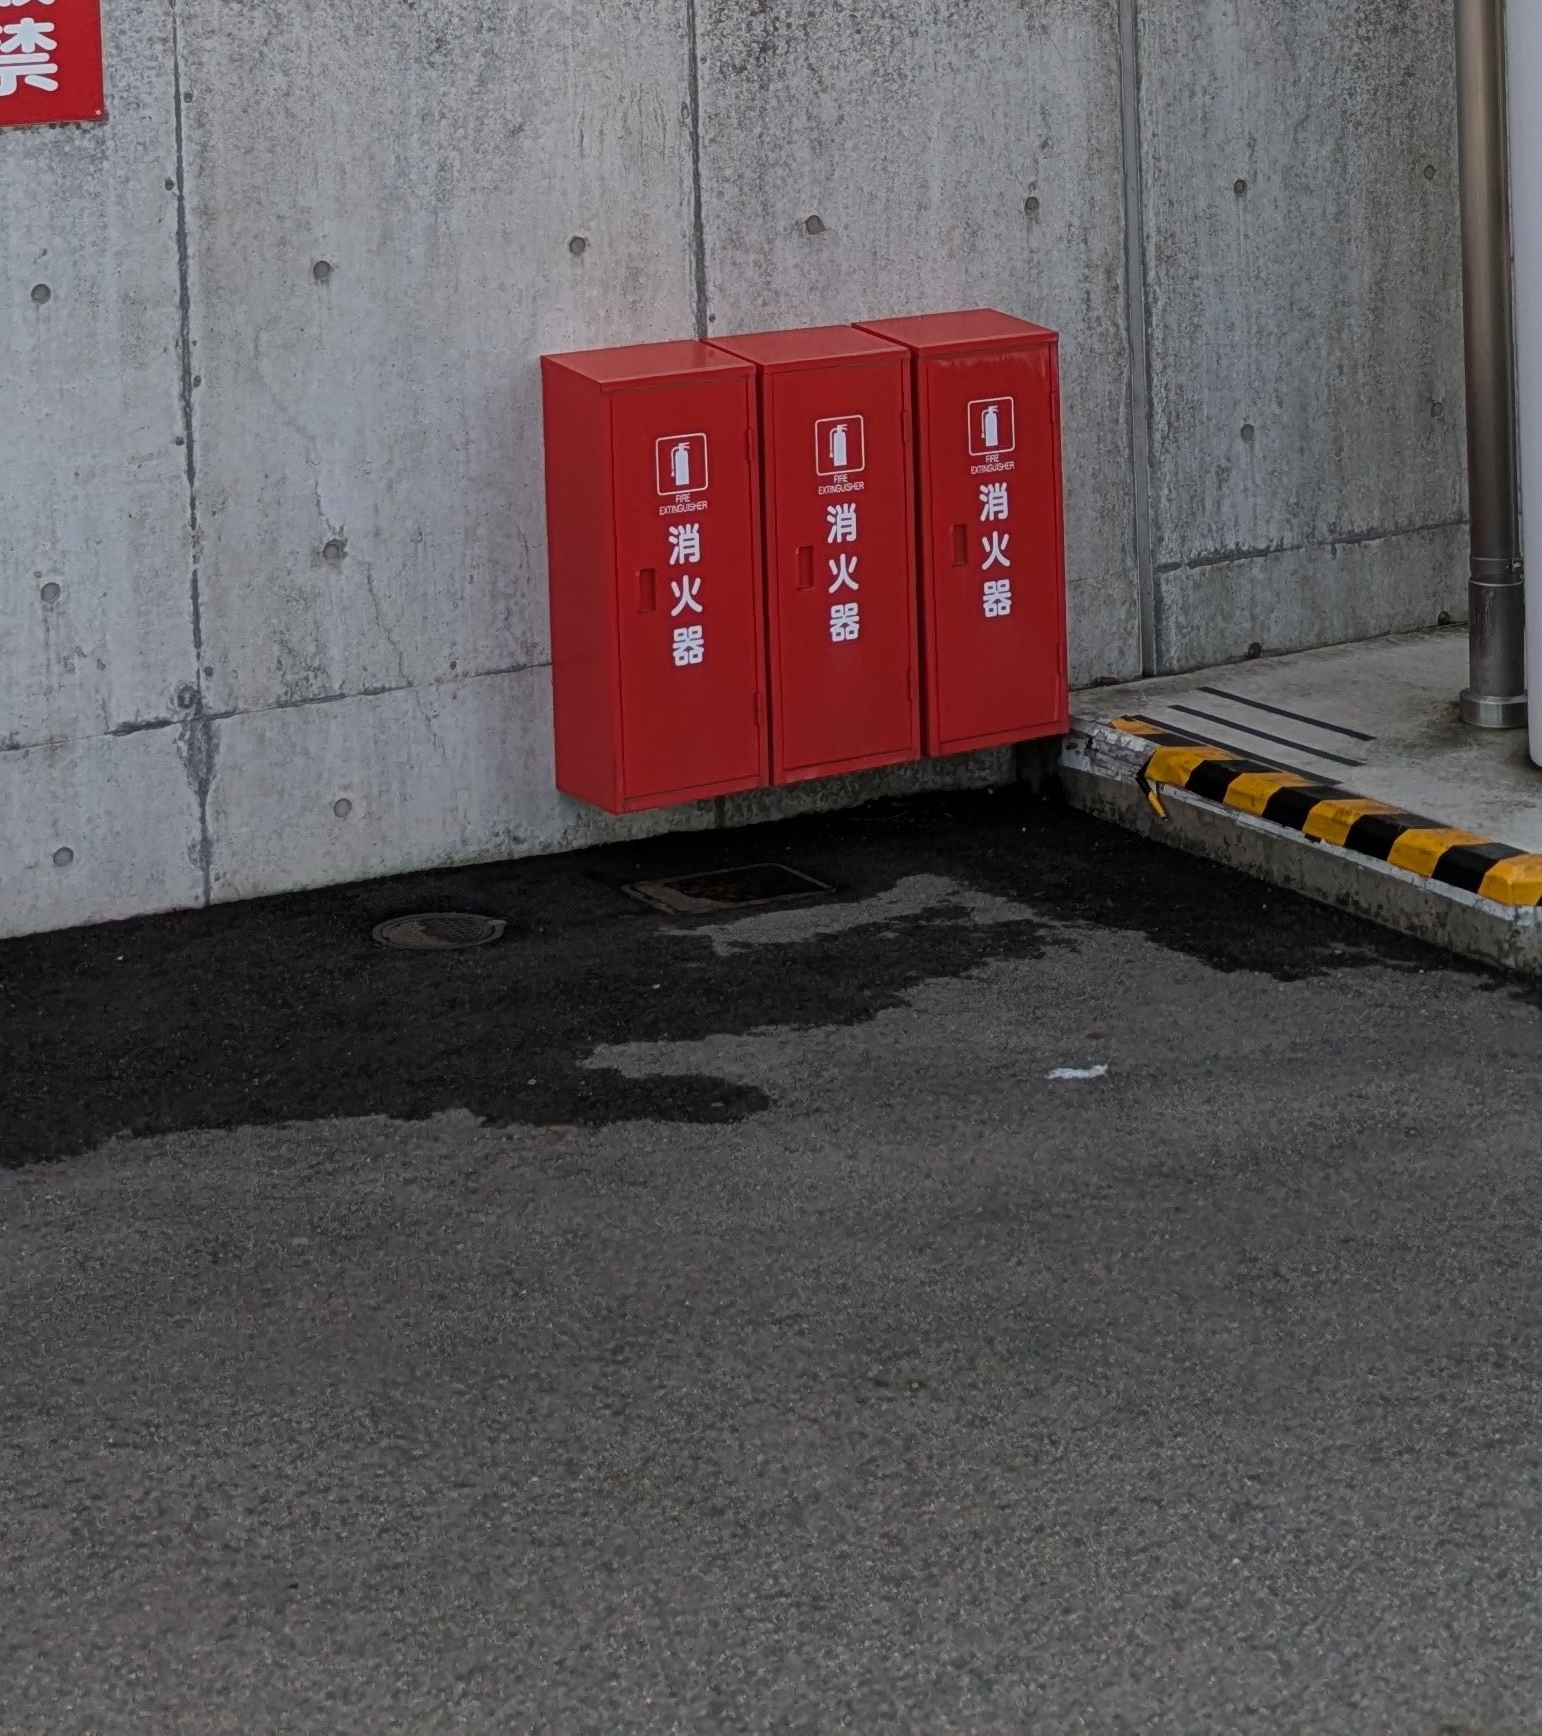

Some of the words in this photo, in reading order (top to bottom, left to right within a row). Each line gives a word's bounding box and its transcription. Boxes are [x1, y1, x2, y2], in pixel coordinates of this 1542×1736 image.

[985, 453, 1000, 464] FIRE
[970, 460, 1016, 475] EXTINGUISHER
[833, 473, 849, 484] FIRE
[818, 480, 865, 496] EXTINGUISHER
[675, 493, 691, 504] FIRE
[659, 500, 708, 516] EXTINGUISHER
[979, 482, 1013, 619] 消火器
[826, 502, 861, 644] 消火器
[668, 523, 705, 668] 消火器
